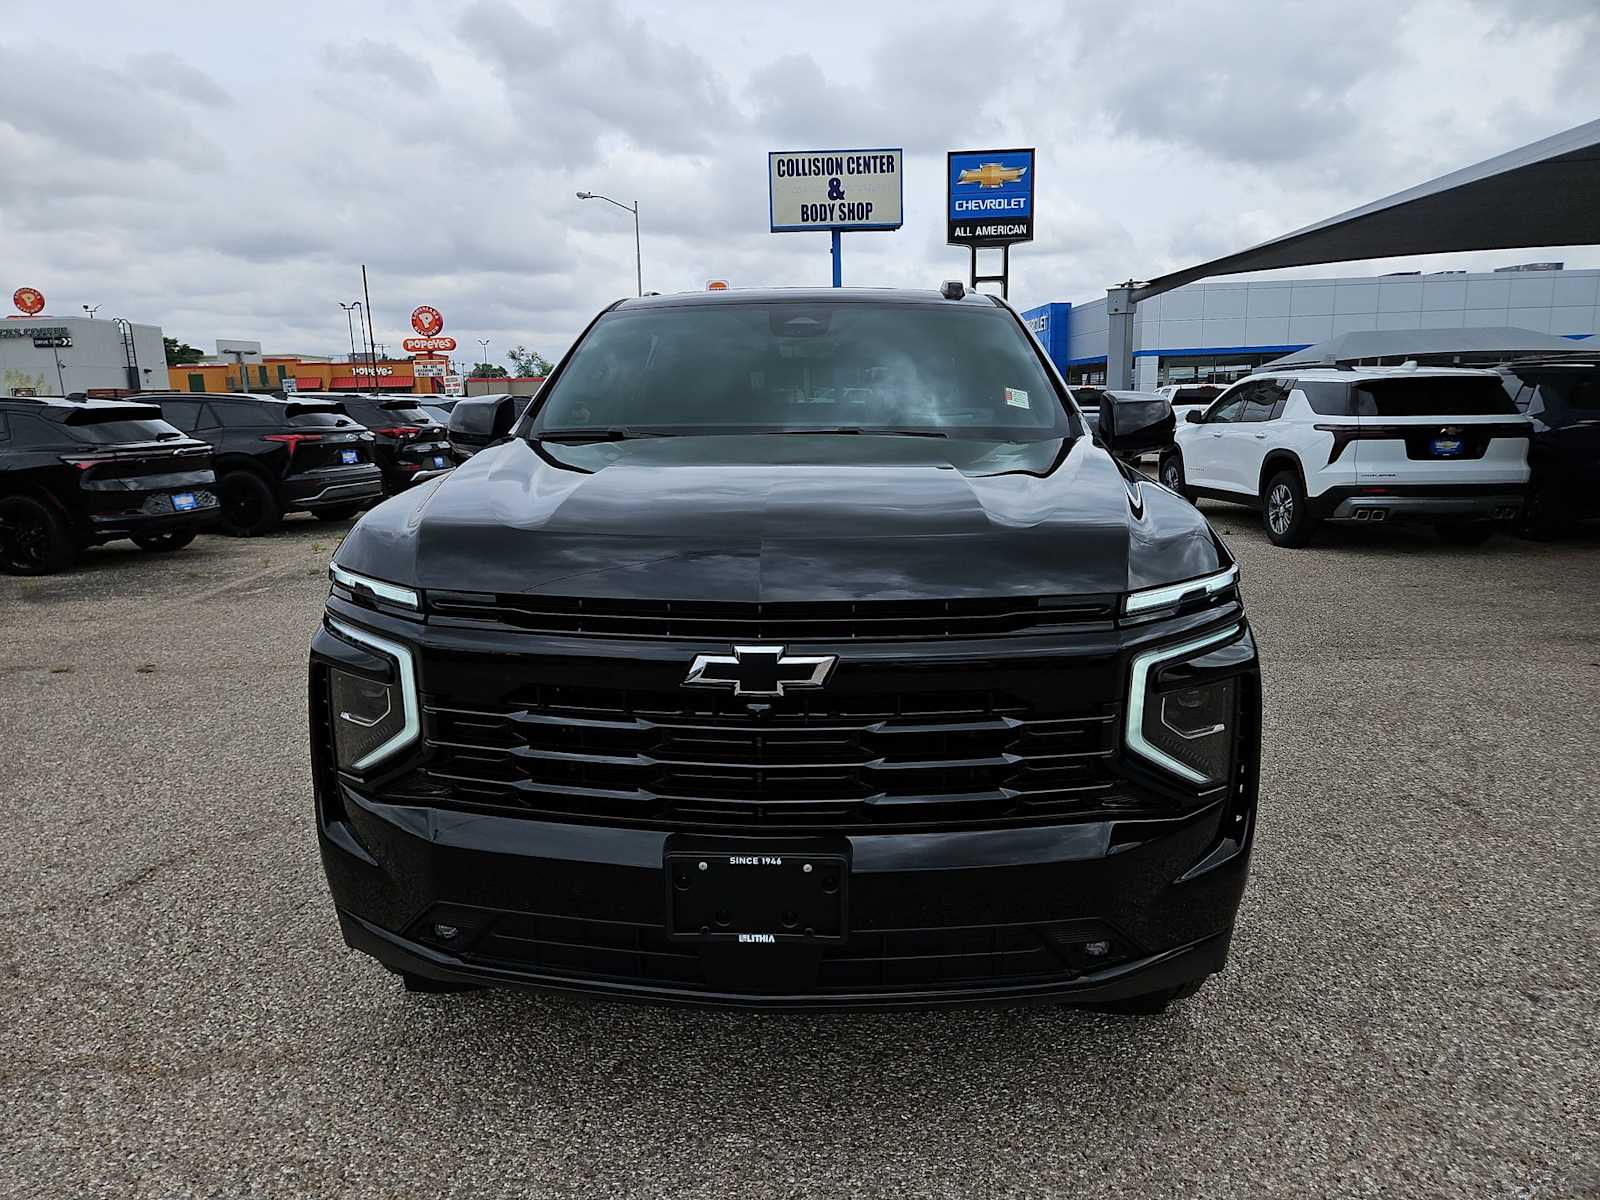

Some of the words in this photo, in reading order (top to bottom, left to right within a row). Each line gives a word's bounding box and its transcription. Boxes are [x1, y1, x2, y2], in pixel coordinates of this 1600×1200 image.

[777, 157, 843, 177] COLLISION
[847, 155, 895, 175] CENTER
[827, 177, 845, 201] &
[801, 203, 835, 222] BODY
[838, 202, 873, 221] SHOP
[955, 197, 1026, 211] CHEVROLET
[954, 226, 973, 237] ALL
[975, 224, 1027, 236] AMERICAN
[729, 856, 759, 865] SINCE
[761, 857, 782, 865] 1946
